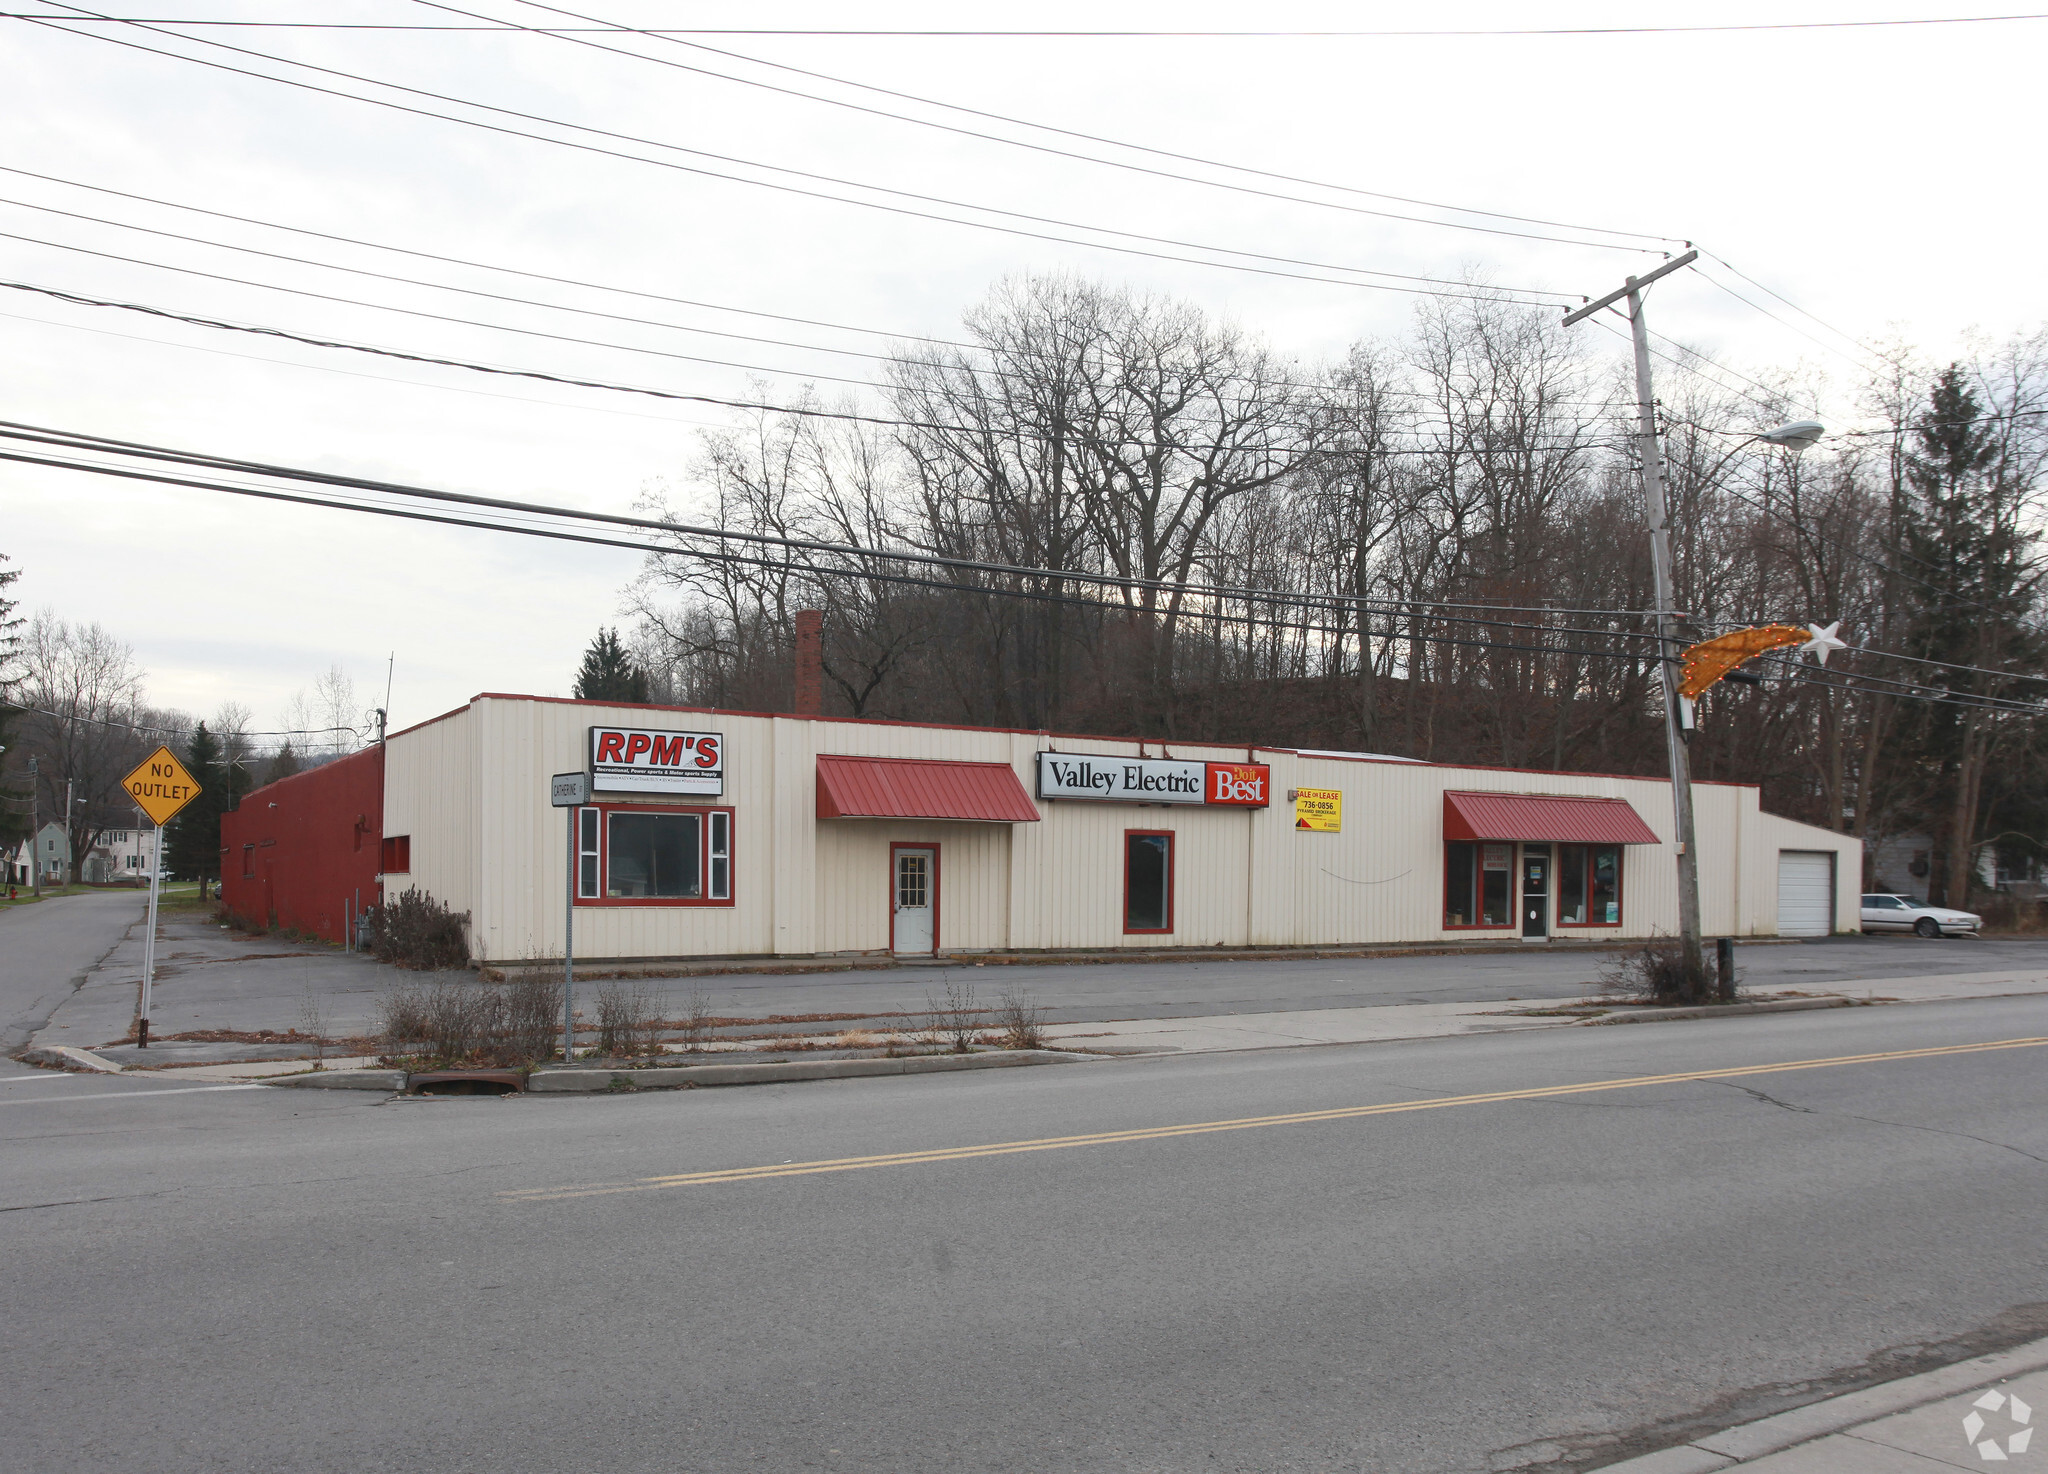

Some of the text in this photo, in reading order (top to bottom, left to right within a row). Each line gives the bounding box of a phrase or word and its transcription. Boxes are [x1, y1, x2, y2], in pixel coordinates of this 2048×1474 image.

[596, 732, 719, 768] RPM'S
[151, 763, 174, 778] NO
[1050, 761, 1200, 795] Valley Electric
[1233, 767, 1257, 781] Do it
[132, 782, 190, 799] OUTLET
[554, 783, 577, 797] CATHERINE
[1214, 770, 1265, 801] Best
[1296, 790, 1311, 798] SALE
[1319, 792, 1339, 800] LEASE
